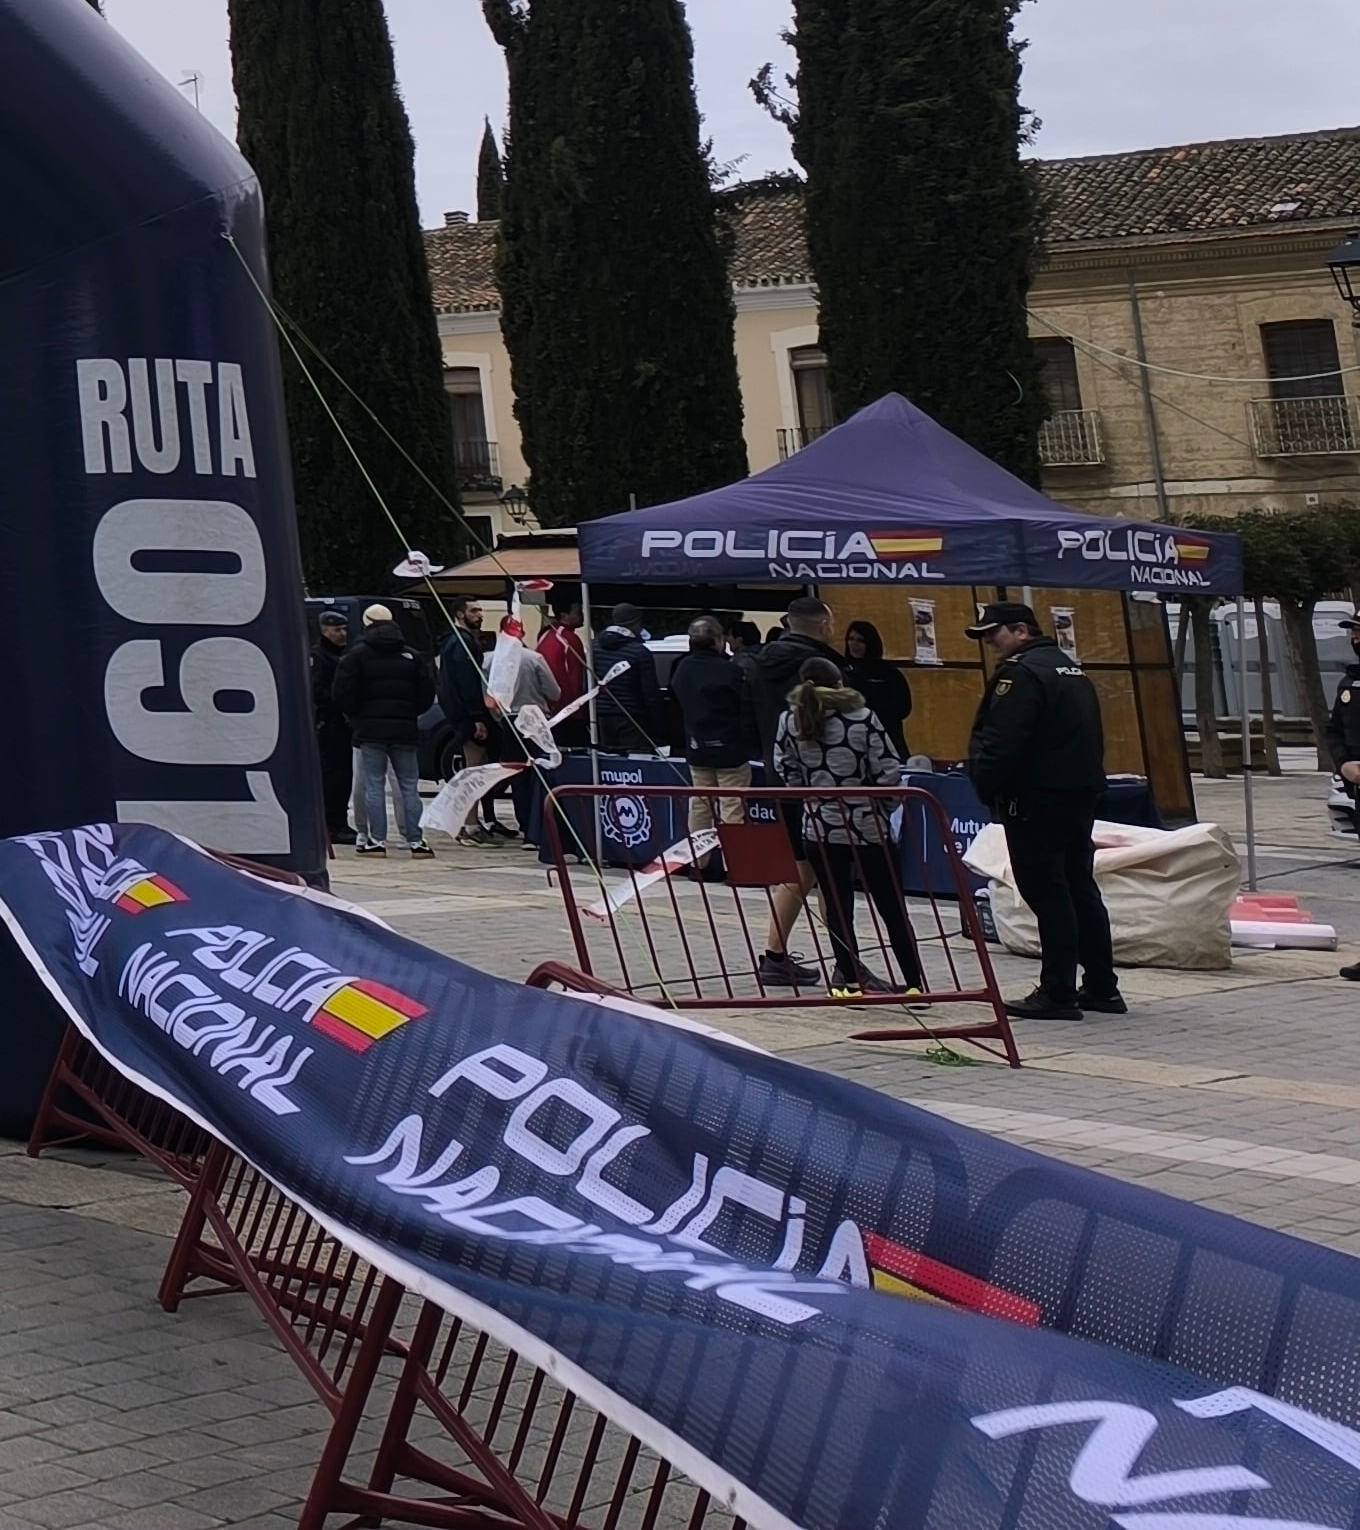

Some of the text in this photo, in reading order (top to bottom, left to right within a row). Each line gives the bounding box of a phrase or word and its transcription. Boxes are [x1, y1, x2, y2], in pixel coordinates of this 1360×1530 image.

[77, 357, 257, 478] RUTA
[769, 562, 945, 578] NACIONAL
[1131, 565, 1211, 586] NACIONAL
[93, 499, 291, 855] 160
[601, 769, 643, 785] mupol
